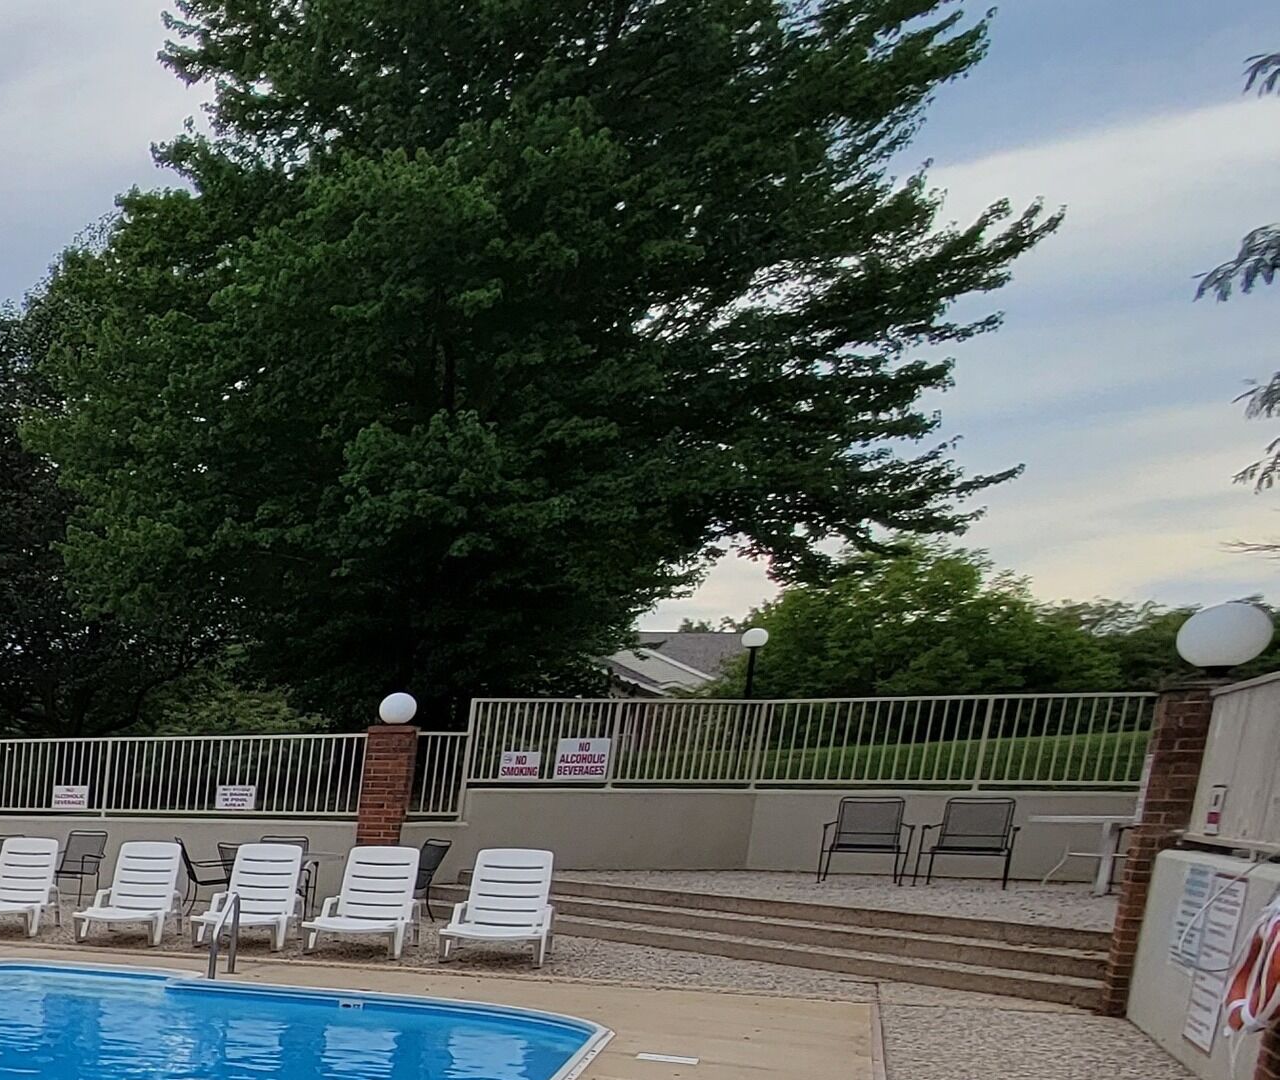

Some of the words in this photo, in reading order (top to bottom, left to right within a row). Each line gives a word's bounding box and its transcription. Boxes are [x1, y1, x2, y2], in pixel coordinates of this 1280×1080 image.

[578, 742, 591, 752] NO
[515, 755, 528, 765] NO
[559, 754, 606, 764] ALCOHOLIC
[501, 766, 539, 776] SMOKING
[557, 766, 605, 776] BEVERAGES
